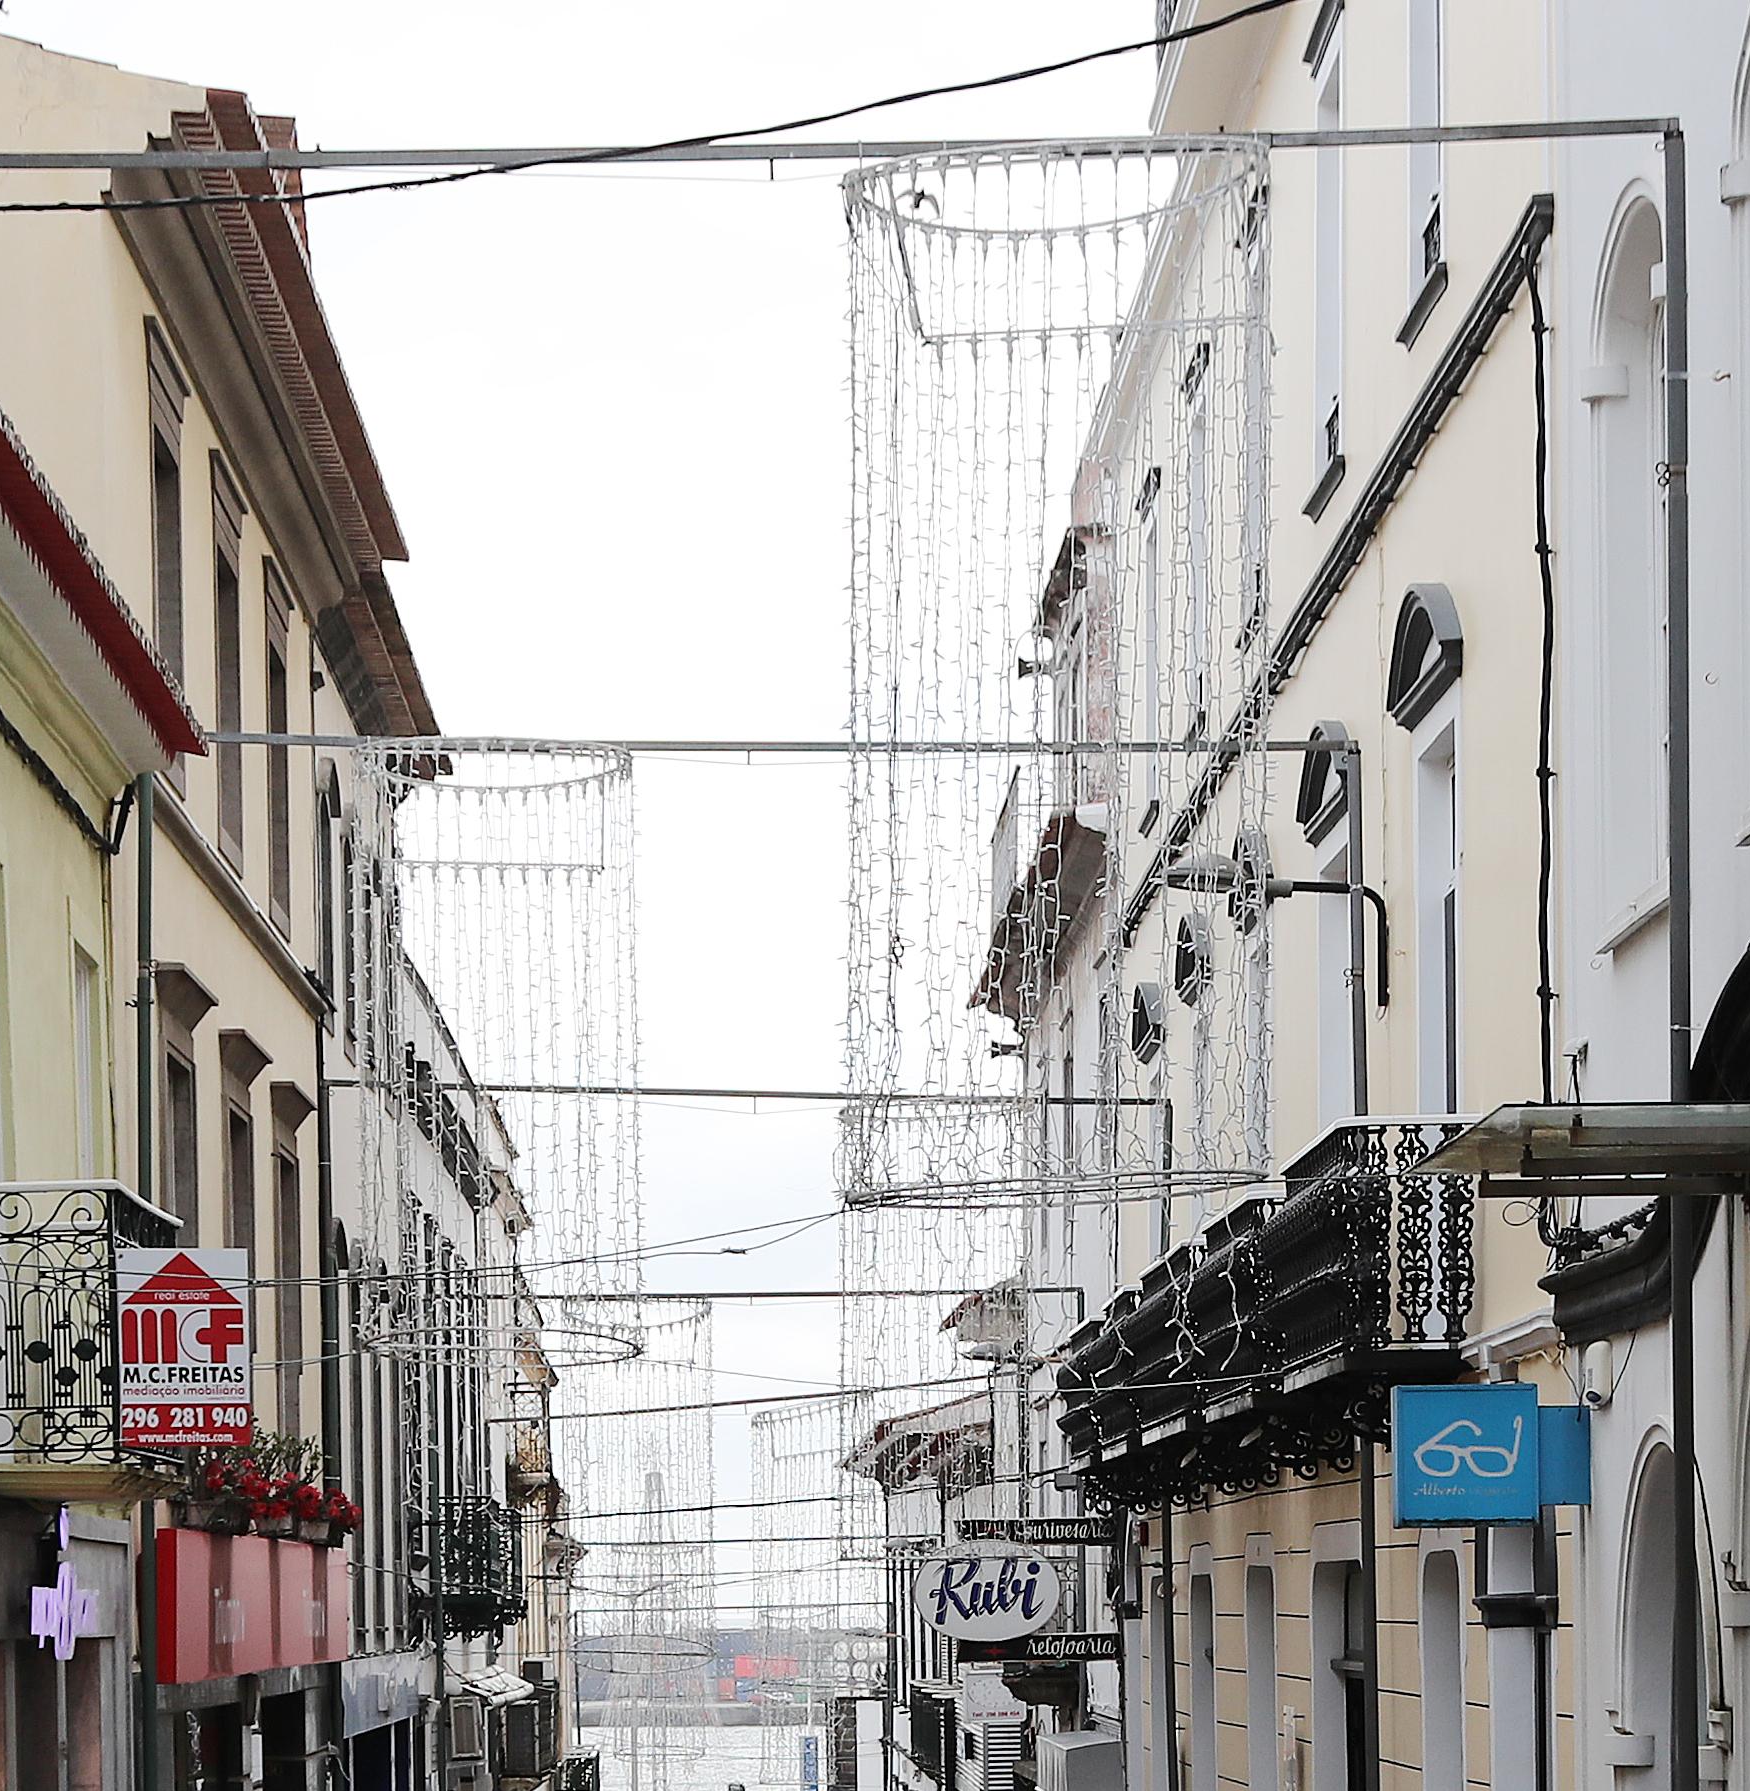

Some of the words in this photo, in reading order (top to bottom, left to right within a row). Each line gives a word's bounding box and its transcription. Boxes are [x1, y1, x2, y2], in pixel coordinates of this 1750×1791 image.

[177, 1291, 211, 1301] estate
[122, 1366, 245, 1384] M.C.FREITAS
[122, 1384, 180, 1399] mediação
[183, 1383, 246, 1397] imobiliária
[121, 1406, 160, 1429] 296
[169, 1406, 205, 1429] 281
[211, 1406, 248, 1429] 940
[137, 1429, 234, 1443] www.mcfreitas.com
[1413, 1483, 1467, 1497] Alberto
[929, 1556, 1044, 1625] Rubi
[1026, 1636, 1117, 1660] relojoaria
